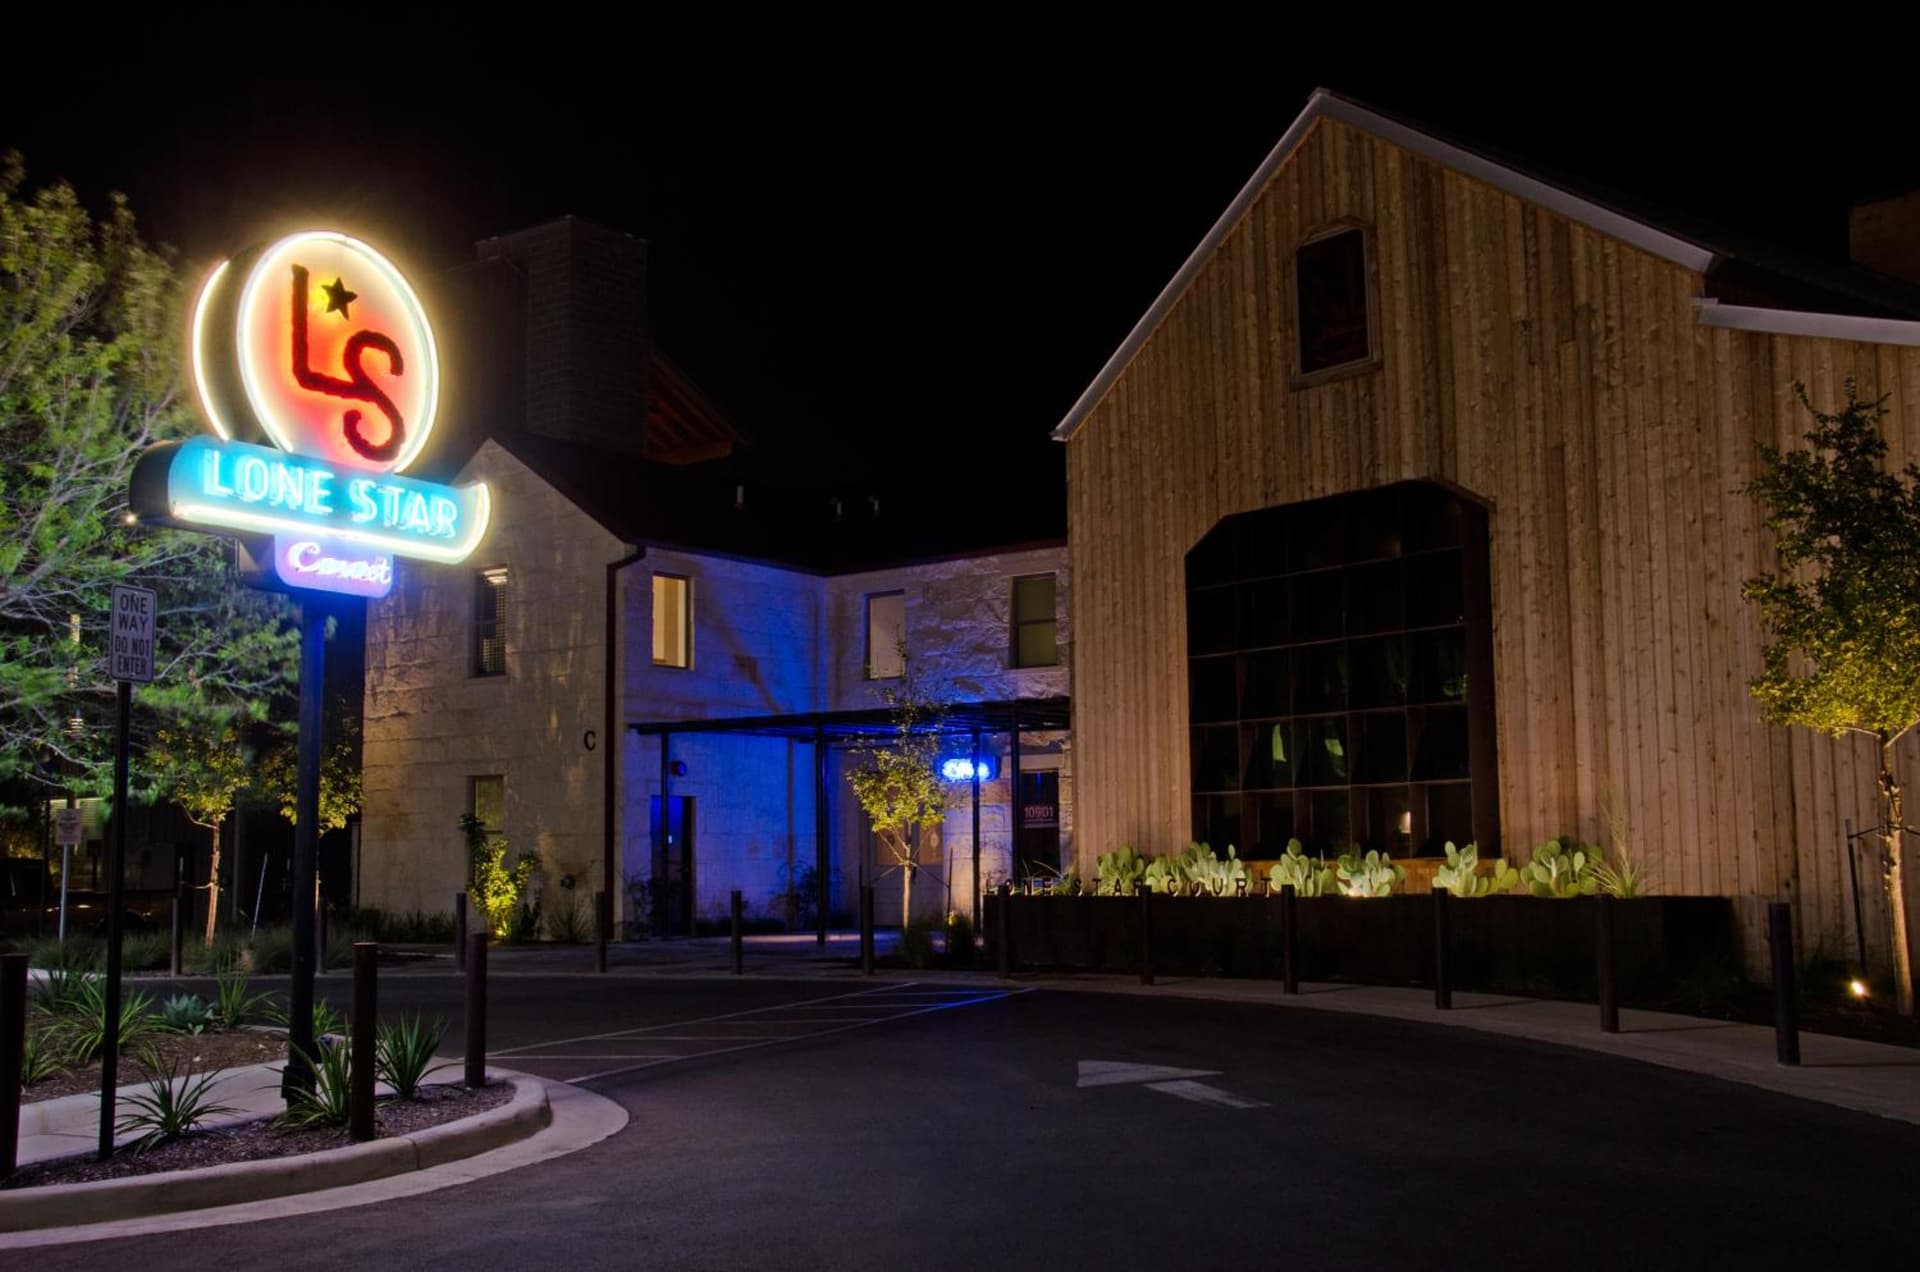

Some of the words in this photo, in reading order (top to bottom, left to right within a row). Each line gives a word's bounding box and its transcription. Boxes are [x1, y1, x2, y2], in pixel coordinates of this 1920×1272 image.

[203, 448, 334, 515] LONE
[349, 478, 458, 538] STAR
[120, 593, 148, 614] ONE
[119, 613, 148, 633] WAY
[114, 635, 128, 653] DO
[132, 638, 149, 657] NOT
[117, 655, 147, 675] ENTER
[583, 730, 597, 751] C
[1166, 876, 1272, 897] COURT
